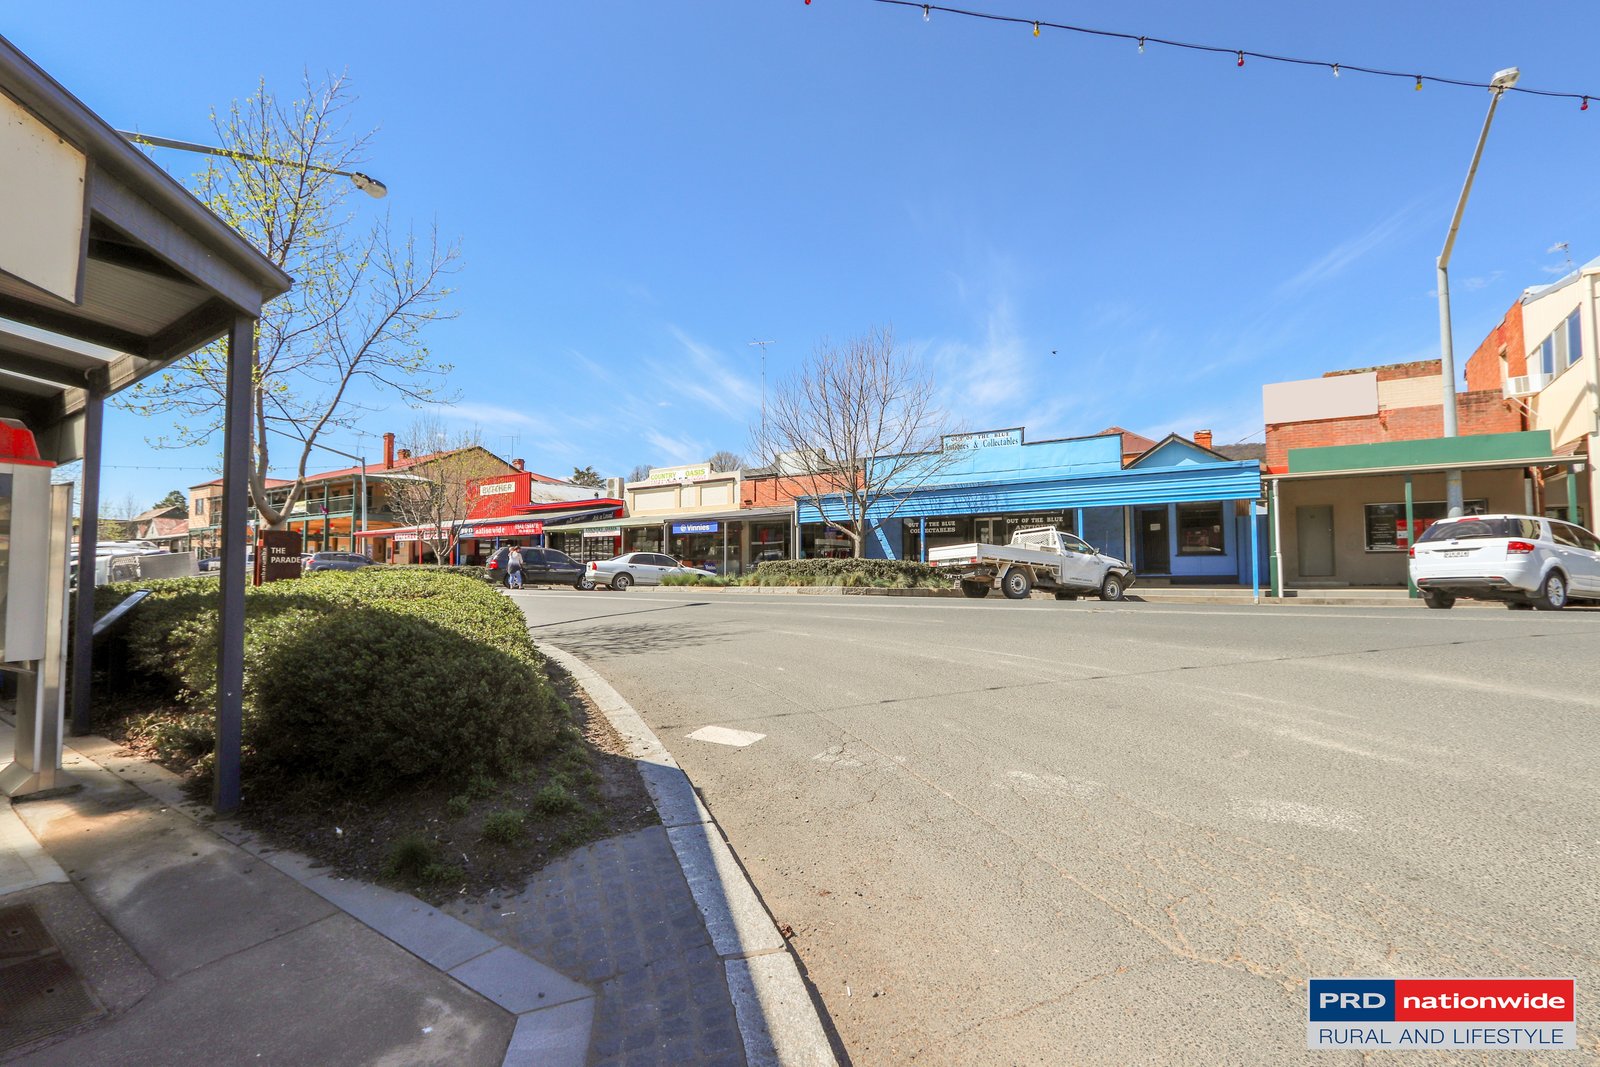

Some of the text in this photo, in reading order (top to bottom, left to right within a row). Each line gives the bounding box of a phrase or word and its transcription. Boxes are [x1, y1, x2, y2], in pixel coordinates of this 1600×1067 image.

[983, 437, 1019, 447] Collectables
[651, 469, 705, 480] COUNTRY OASIS
[482, 484, 513, 494] BUTCHER
[475, 526, 505, 534] nationwide
[687, 523, 710, 531] Vinnies
